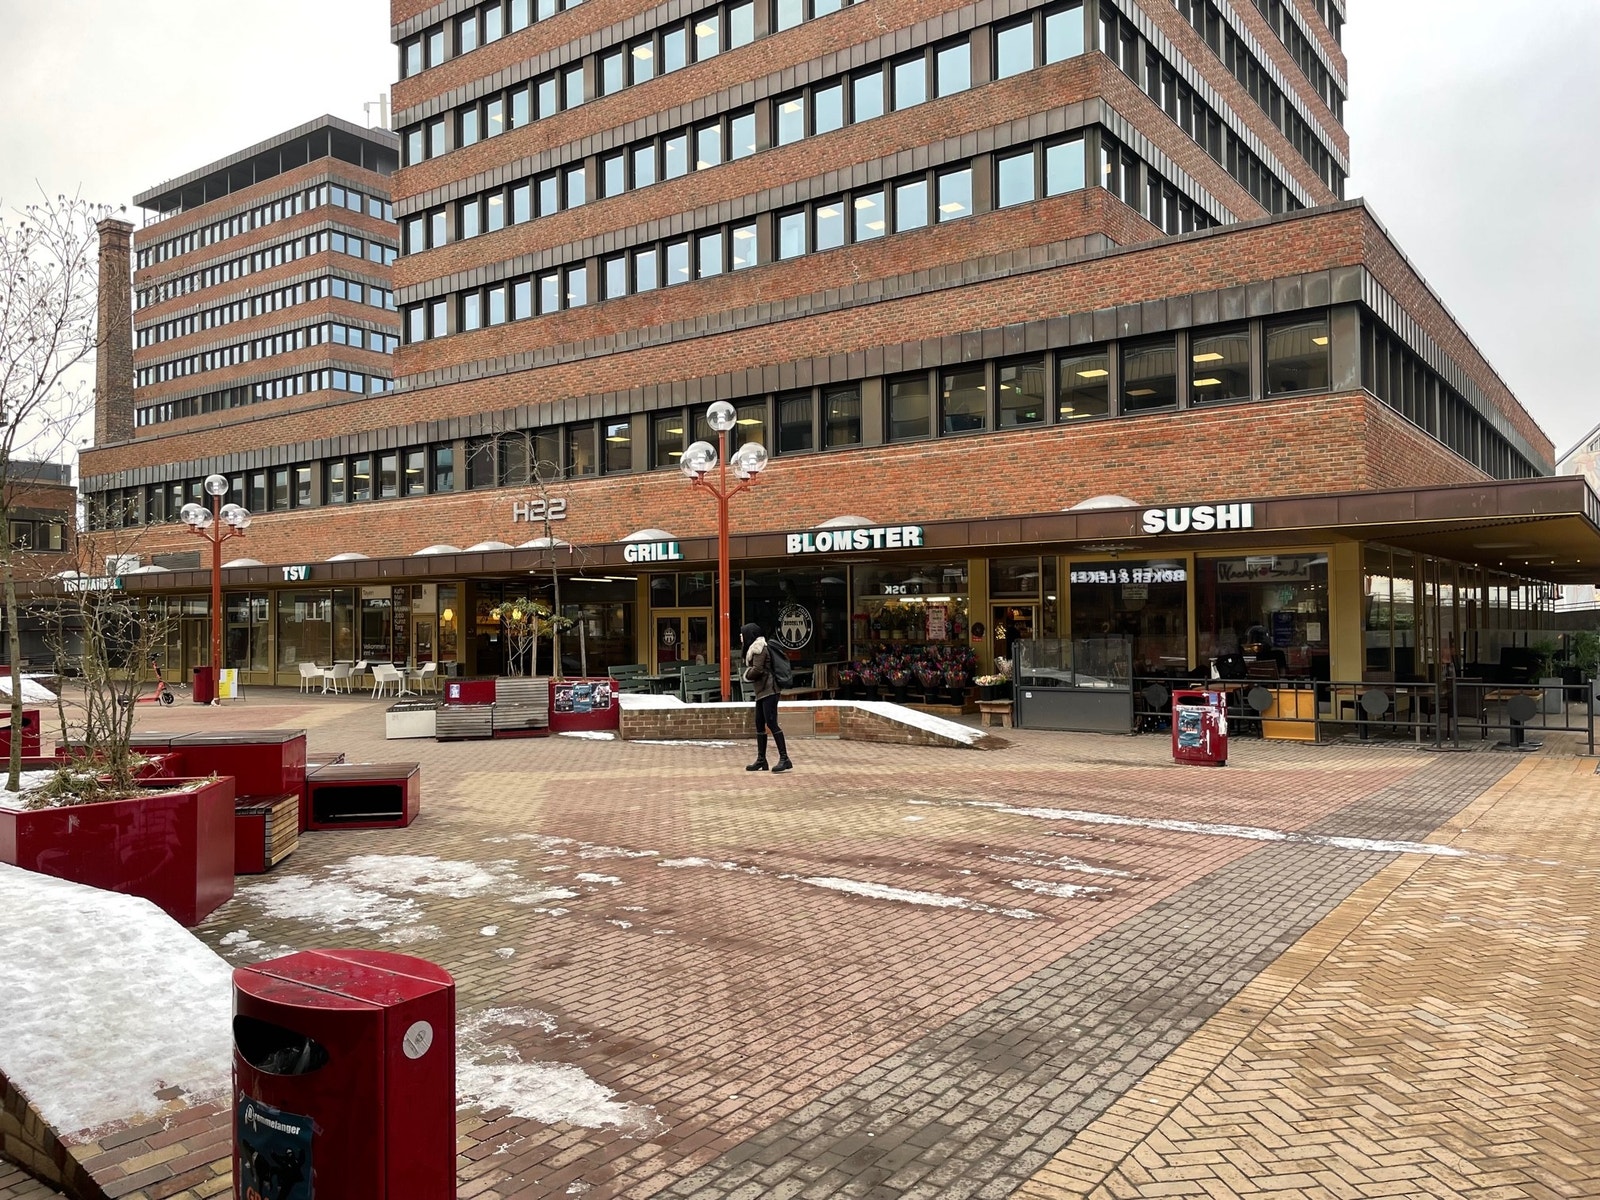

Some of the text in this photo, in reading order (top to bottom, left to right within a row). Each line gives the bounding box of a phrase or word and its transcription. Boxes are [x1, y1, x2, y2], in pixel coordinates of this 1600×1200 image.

[513, 498, 567, 523] H22
[1142, 503, 1254, 535] SUSHI
[623, 541, 683, 563] GRILL
[786, 525, 923, 555] BLOMSTER
[282, 565, 309, 581] TSV
